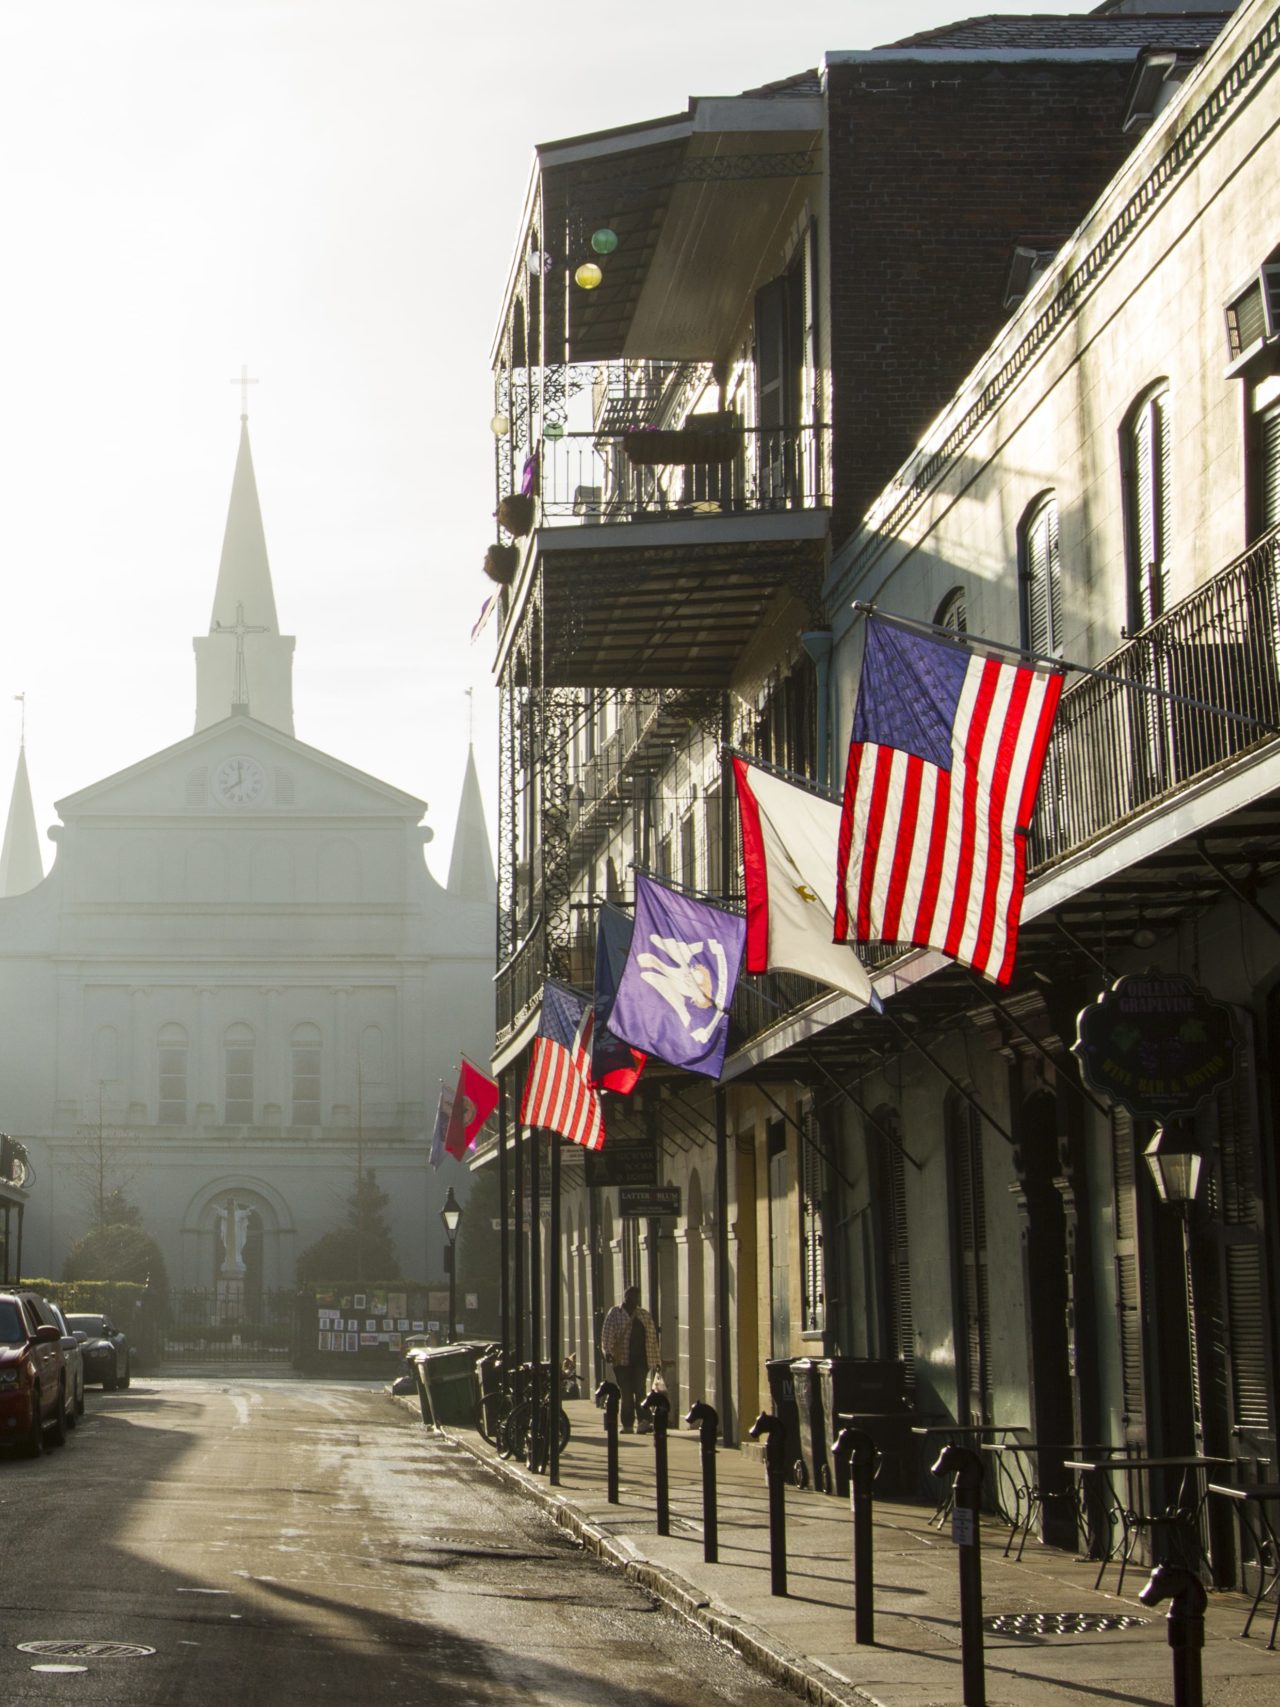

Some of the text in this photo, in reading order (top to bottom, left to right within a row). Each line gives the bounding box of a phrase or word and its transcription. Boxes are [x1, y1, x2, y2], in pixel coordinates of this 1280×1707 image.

[1126, 981, 1187, 996] ORLEANS
[1119, 997, 1195, 1013] GRAPEVINE
[657, 1192, 680, 1201] BLUM
